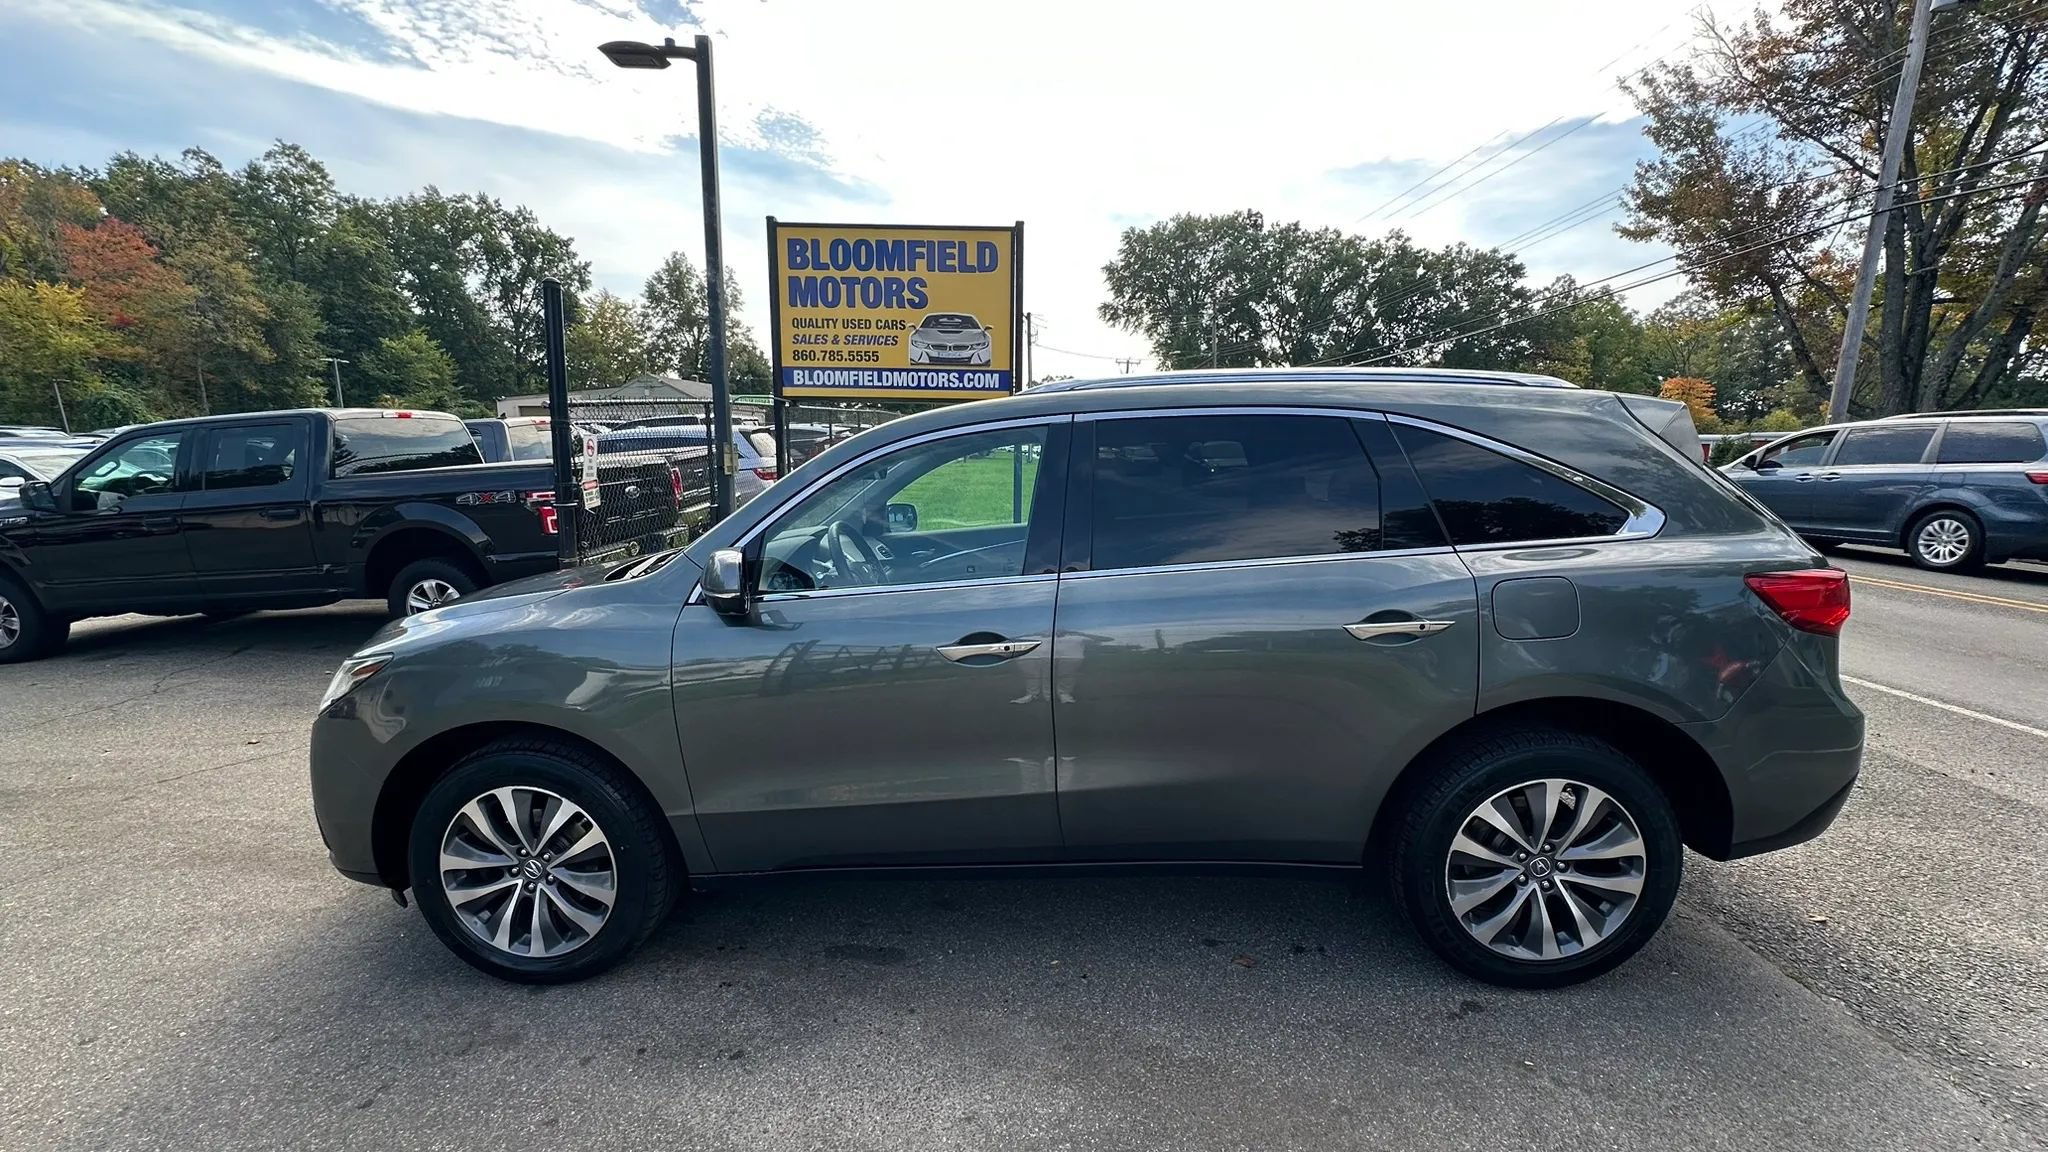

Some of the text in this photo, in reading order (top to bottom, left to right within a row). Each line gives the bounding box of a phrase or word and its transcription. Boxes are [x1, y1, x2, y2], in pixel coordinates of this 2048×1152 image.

[787, 238, 999, 273] BLOOMFIELD
[788, 276, 929, 309] MOTORS
[792, 317, 907, 331] QUALITY USED CARS
[792, 334, 899, 346] SALES & SERVICES
[792, 349, 880, 362] 860.785.5555
[793, 369, 1000, 389] BLOOMFIELDMOTORS.COM
